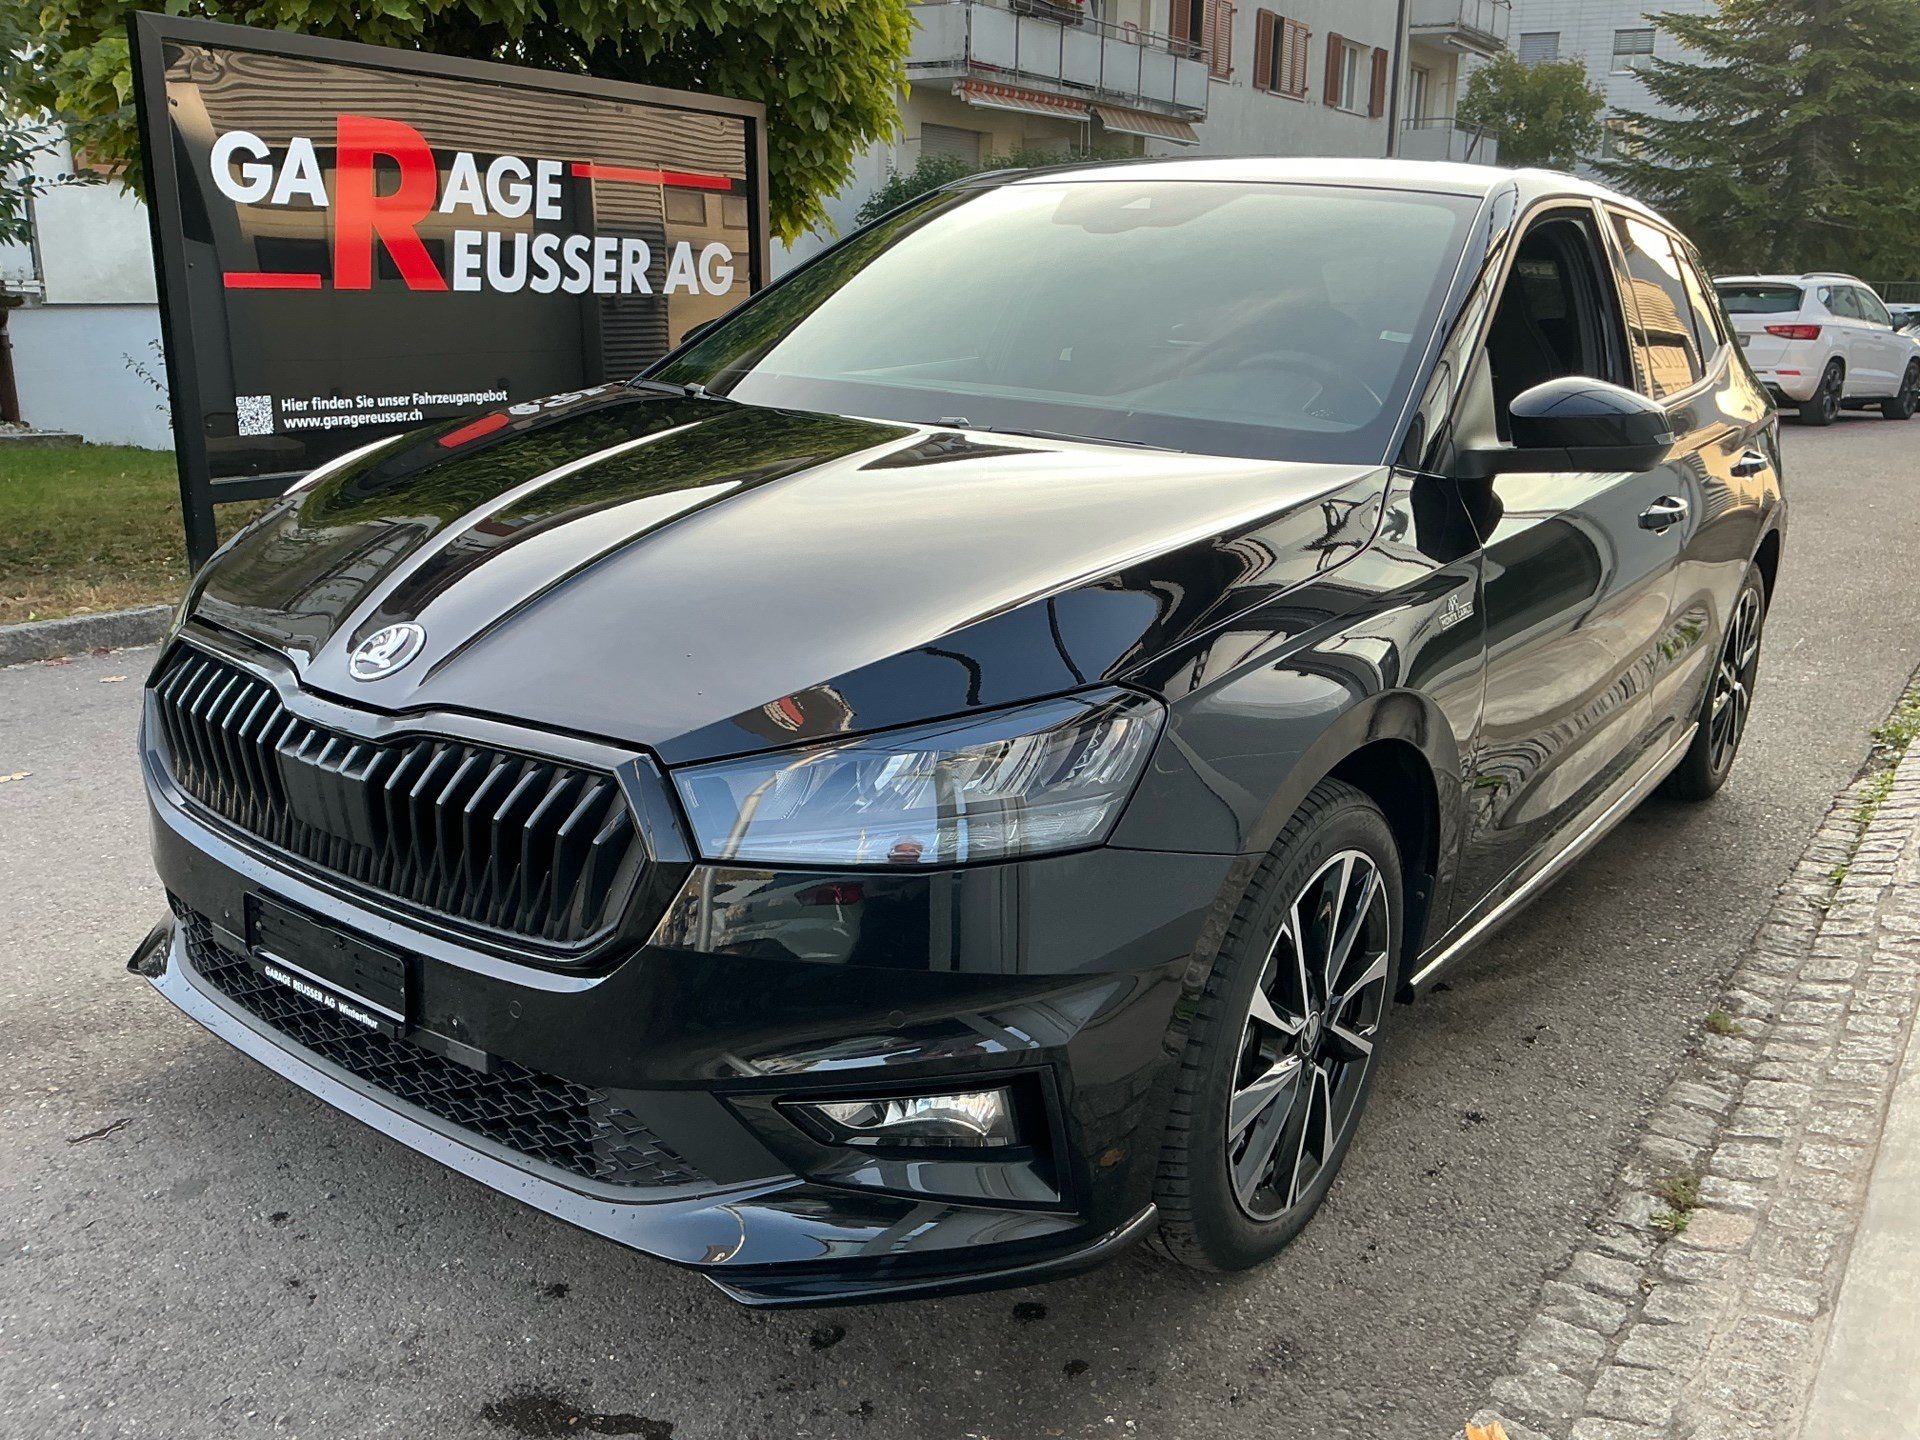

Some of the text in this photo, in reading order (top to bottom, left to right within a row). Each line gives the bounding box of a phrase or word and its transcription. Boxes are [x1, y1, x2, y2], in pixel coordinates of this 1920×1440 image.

[210, 114, 563, 291] GARAGE
[662, 241, 734, 296] AG
[281, 397, 309, 412] Hier
[311, 396, 353, 411] finden
[355, 395, 375, 409] Sie
[377, 393, 410, 408] unser
[412, 389, 509, 406] Fahrzeugangebot
[283, 408, 424, 430] www.garagereusser.ch
[1262, 841, 1322, 939] KUMHO
[264, 965, 379, 1029] GARAGE REUSSER AG Winterthur
